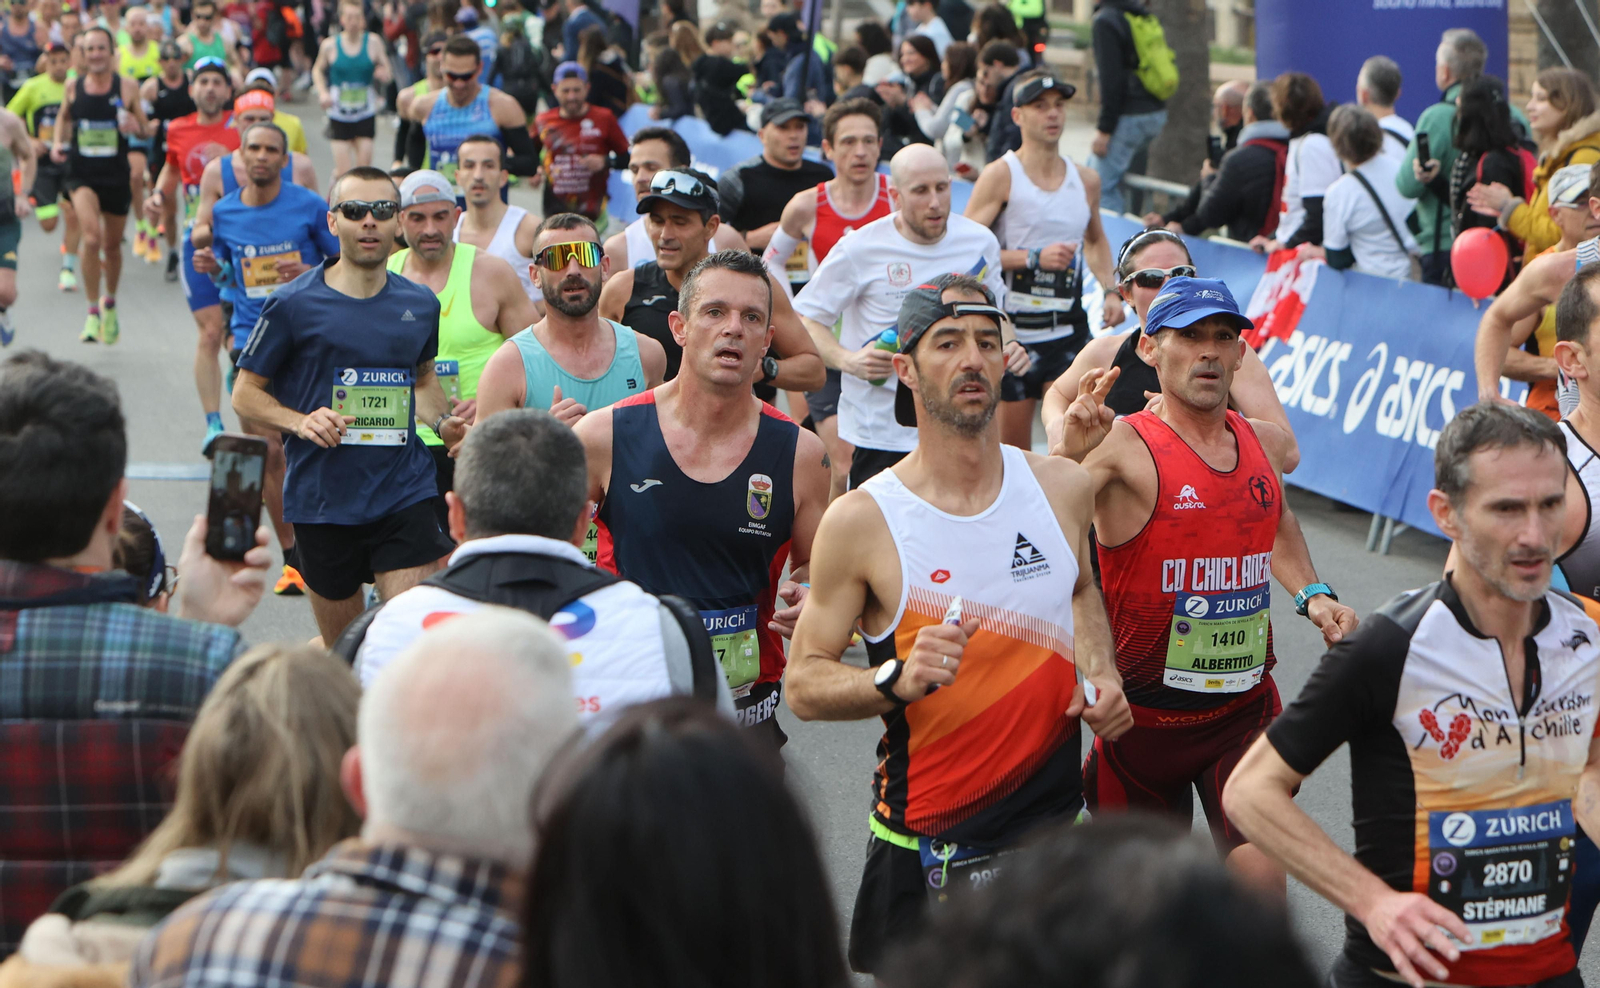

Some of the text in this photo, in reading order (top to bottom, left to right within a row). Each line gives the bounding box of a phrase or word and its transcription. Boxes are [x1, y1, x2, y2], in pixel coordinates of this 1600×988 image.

[362, 371, 405, 384] ZURICH
[360, 396, 388, 409] 1721
[354, 416, 396, 427] RICARDO
[1161, 558, 1187, 593] CD
[1215, 593, 1263, 614] ZURICH
[703, 612, 746, 631] URICH
[1211, 629, 1246, 648] 1410
[1191, 654, 1254, 671] ALBERTITO
[1484, 809, 1563, 838] ZURICH
[1482, 859, 1533, 888] 2870
[1463, 894, 1548, 921] STÉPHANE
